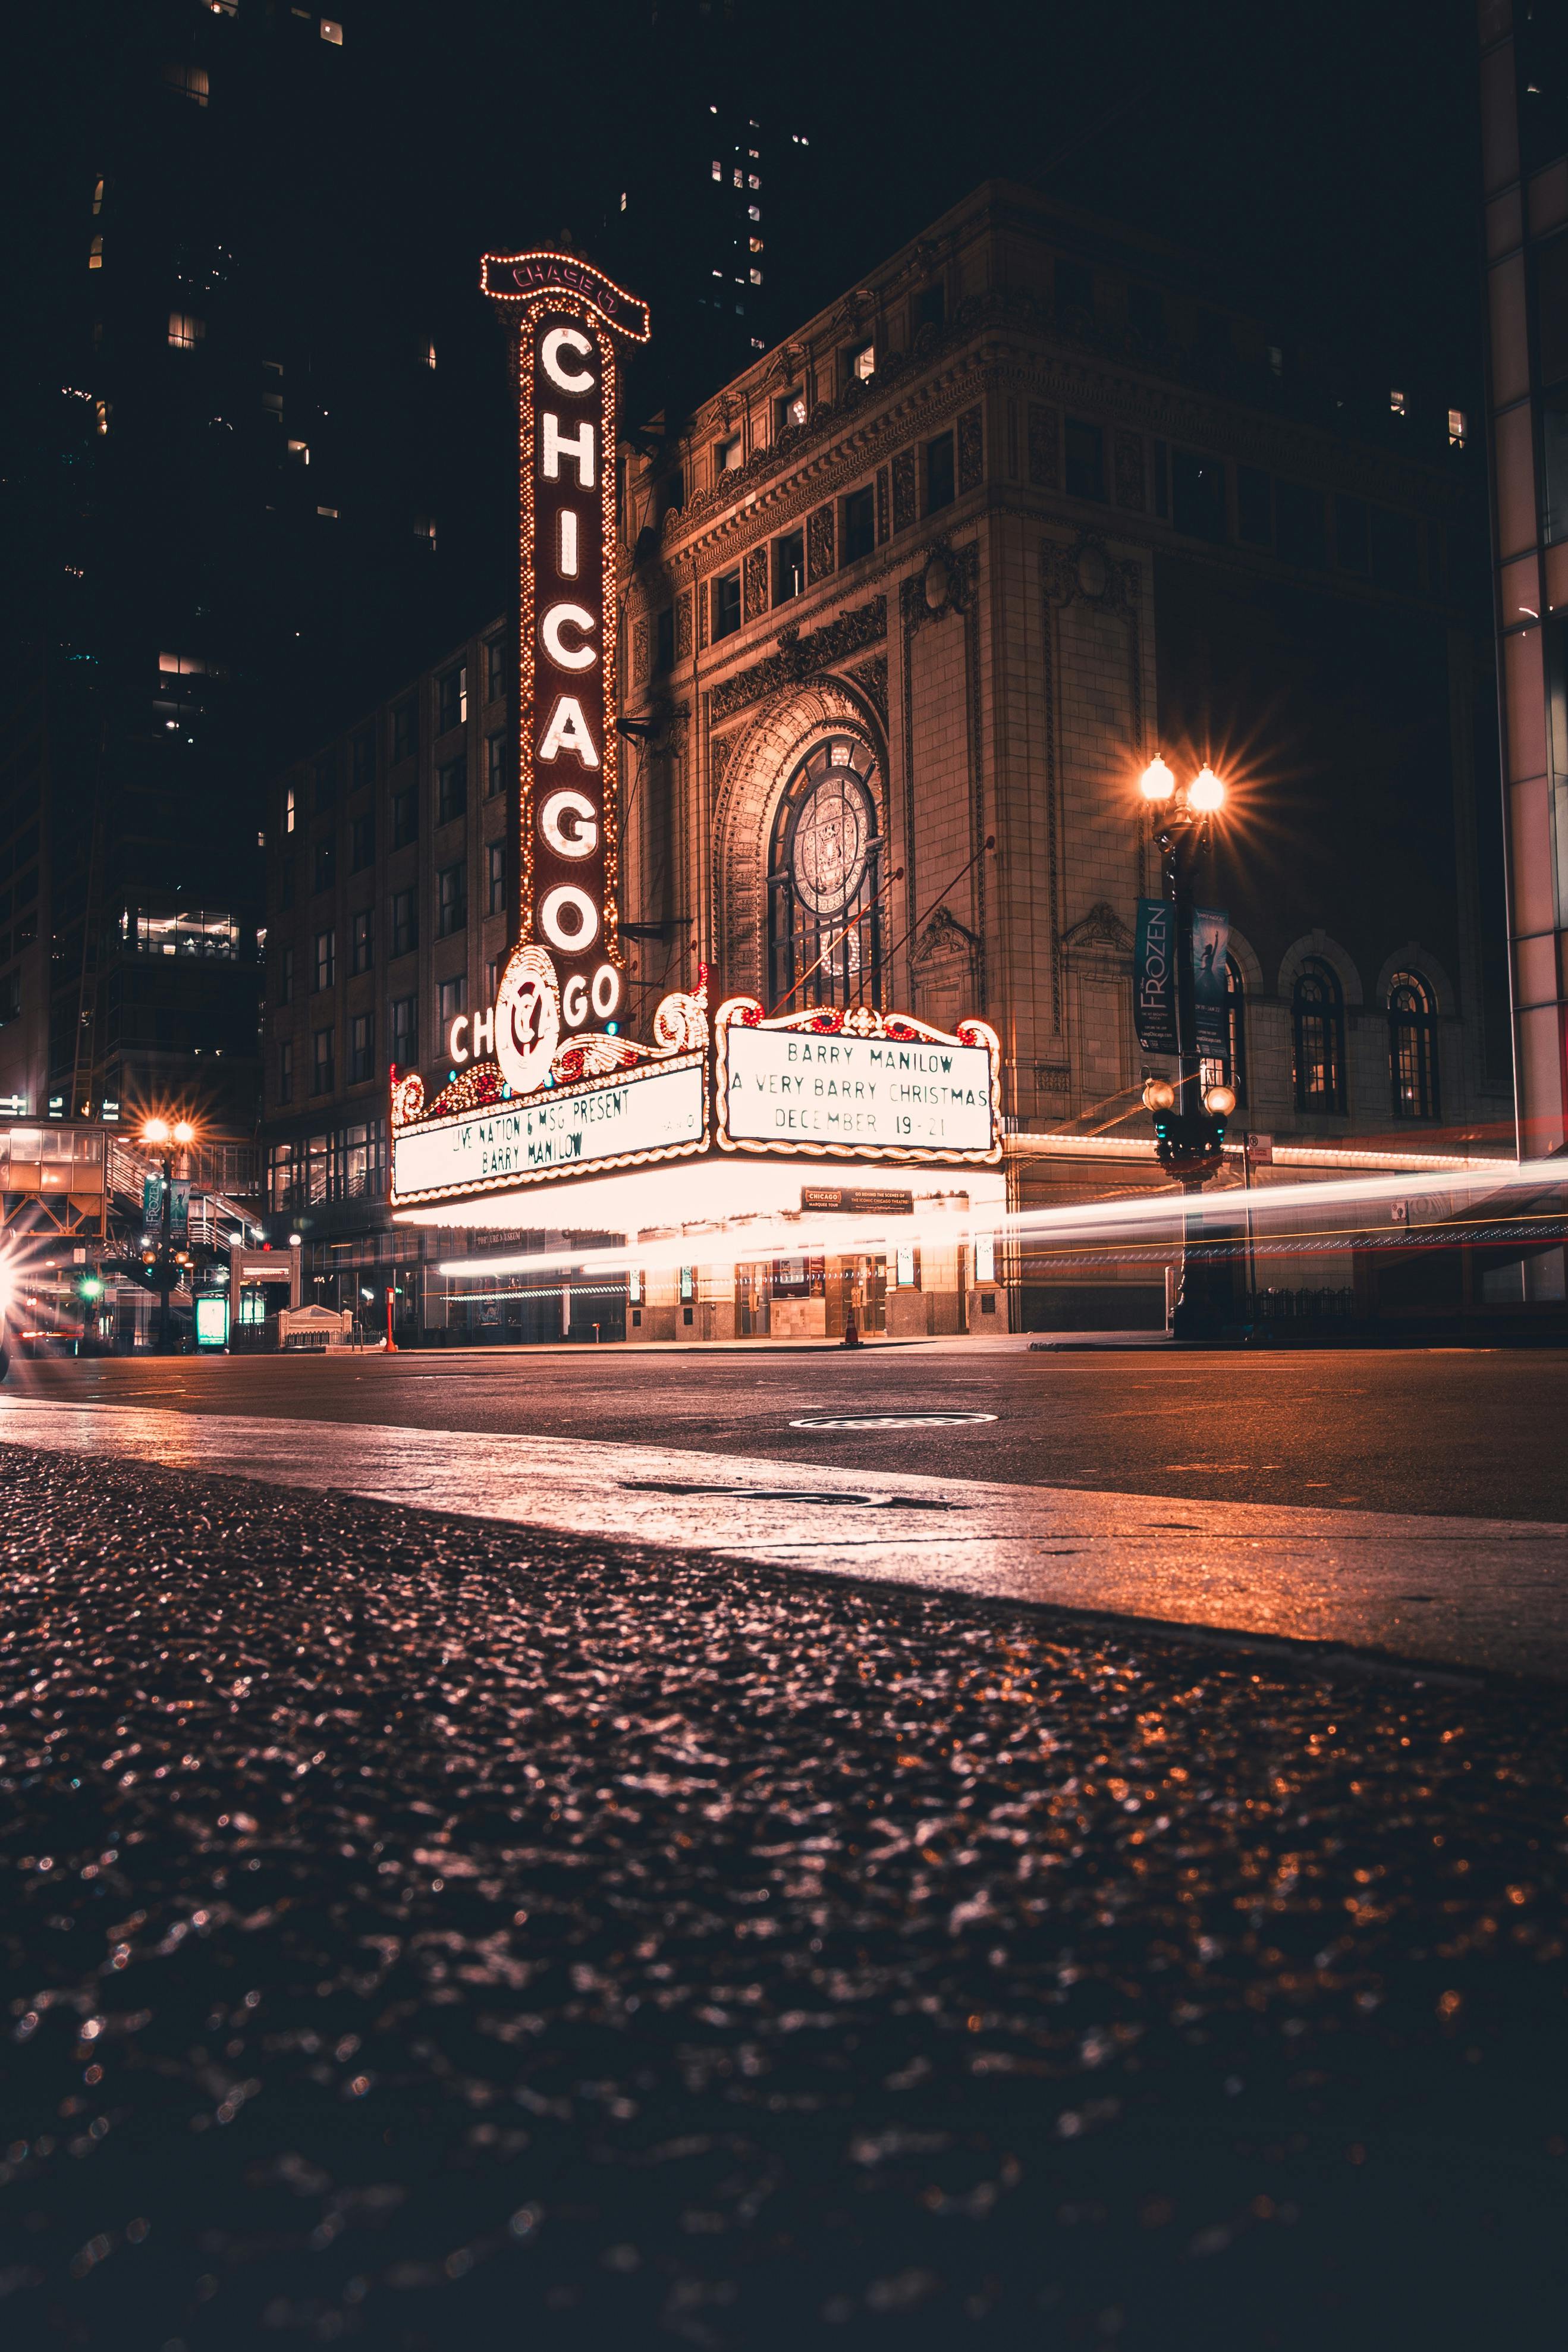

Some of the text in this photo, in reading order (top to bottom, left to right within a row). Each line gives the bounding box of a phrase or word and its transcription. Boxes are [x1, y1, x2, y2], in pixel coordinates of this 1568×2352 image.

[513, 265, 594, 296] CHASE
[539, 328, 600, 952] CHICAGO
[1140, 907, 1170, 1009] FROZEN
[788, 1042, 953, 1073] BARRY MANILOW
[731, 1072, 987, 1107] A VERY BARRY CHRISTMAS
[453, 1127, 473, 1151] LIVE
[479, 1116, 520, 1144] NATION
[539, 1106, 564, 1131] MSG
[573, 1089, 629, 1126] PRESENT
[775, 1109, 877, 1132] DECEMBER
[482, 1131, 582, 1174] BARRY MANILOW
[146, 1180, 162, 1222] FROZEN
